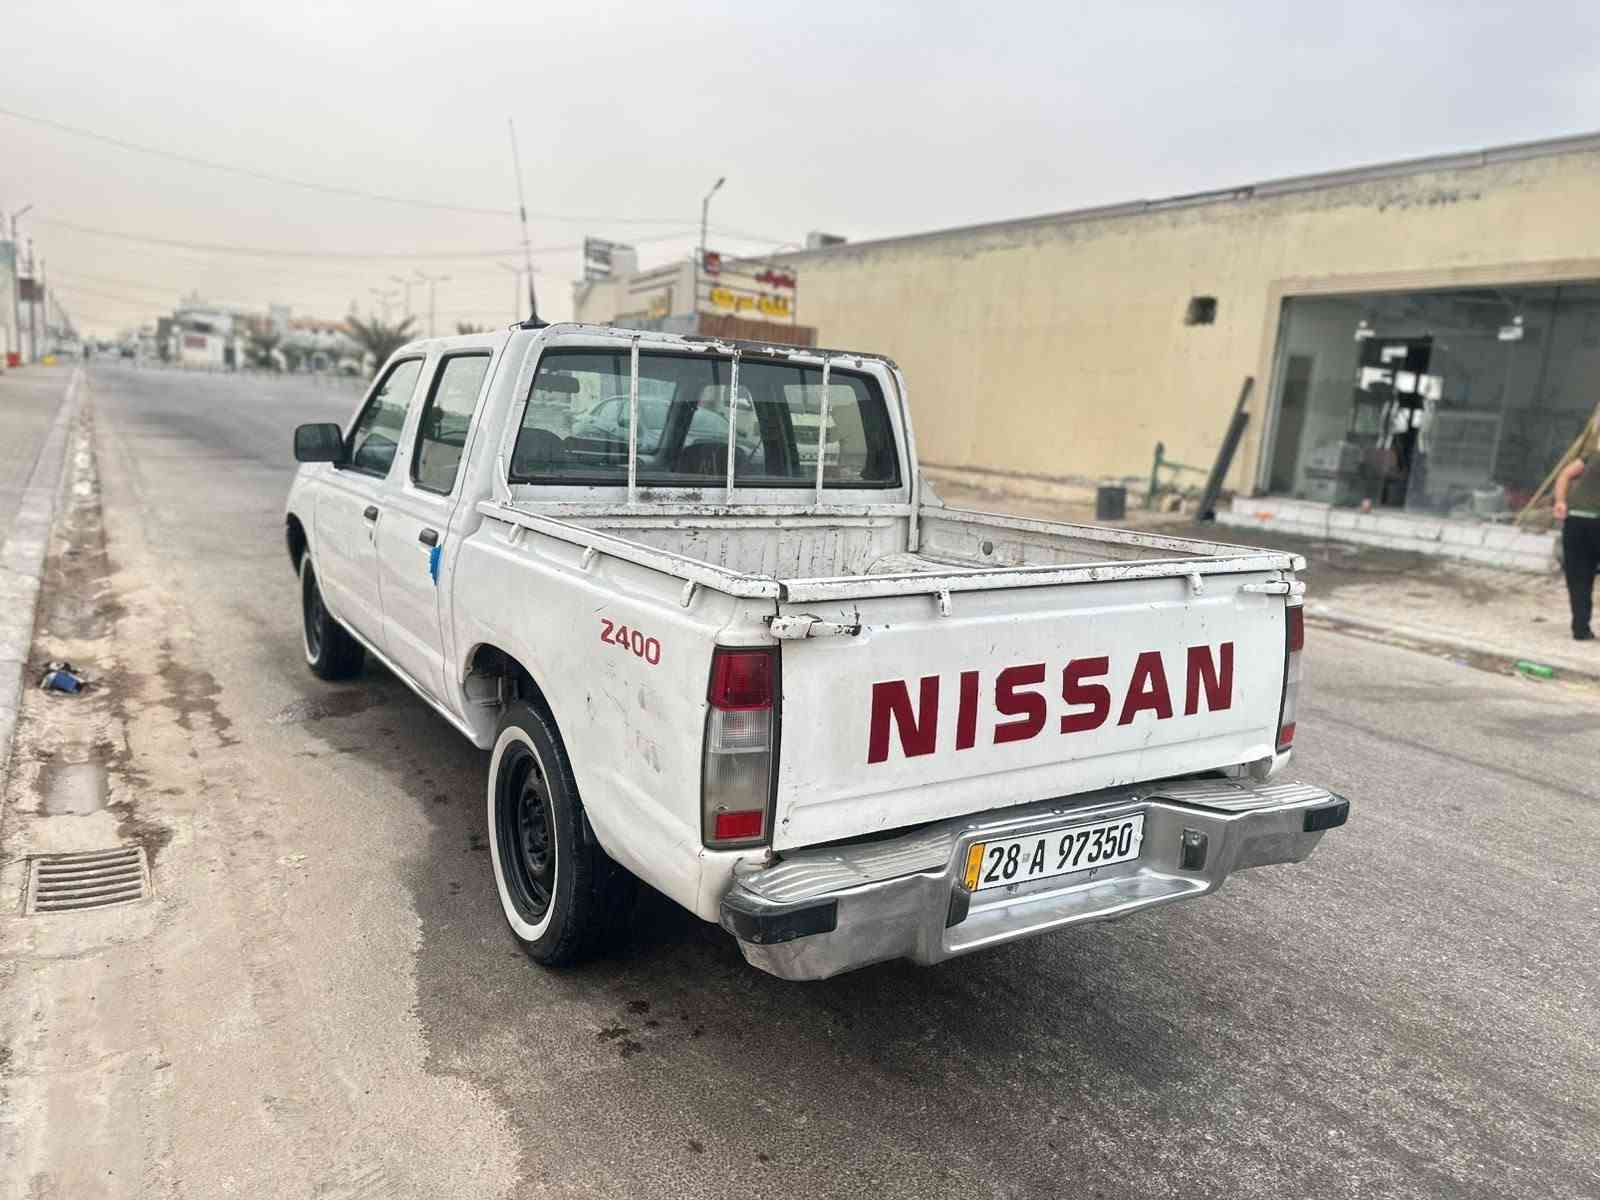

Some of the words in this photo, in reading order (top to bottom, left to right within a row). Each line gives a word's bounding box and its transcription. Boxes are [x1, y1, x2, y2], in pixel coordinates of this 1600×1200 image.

[600, 618, 660, 665] 2400
[868, 642, 1233, 764] NISSAN
[984, 843, 1021, 883] 28
[1029, 839, 1046, 875] A
[1057, 822, 1133, 869] 97350
